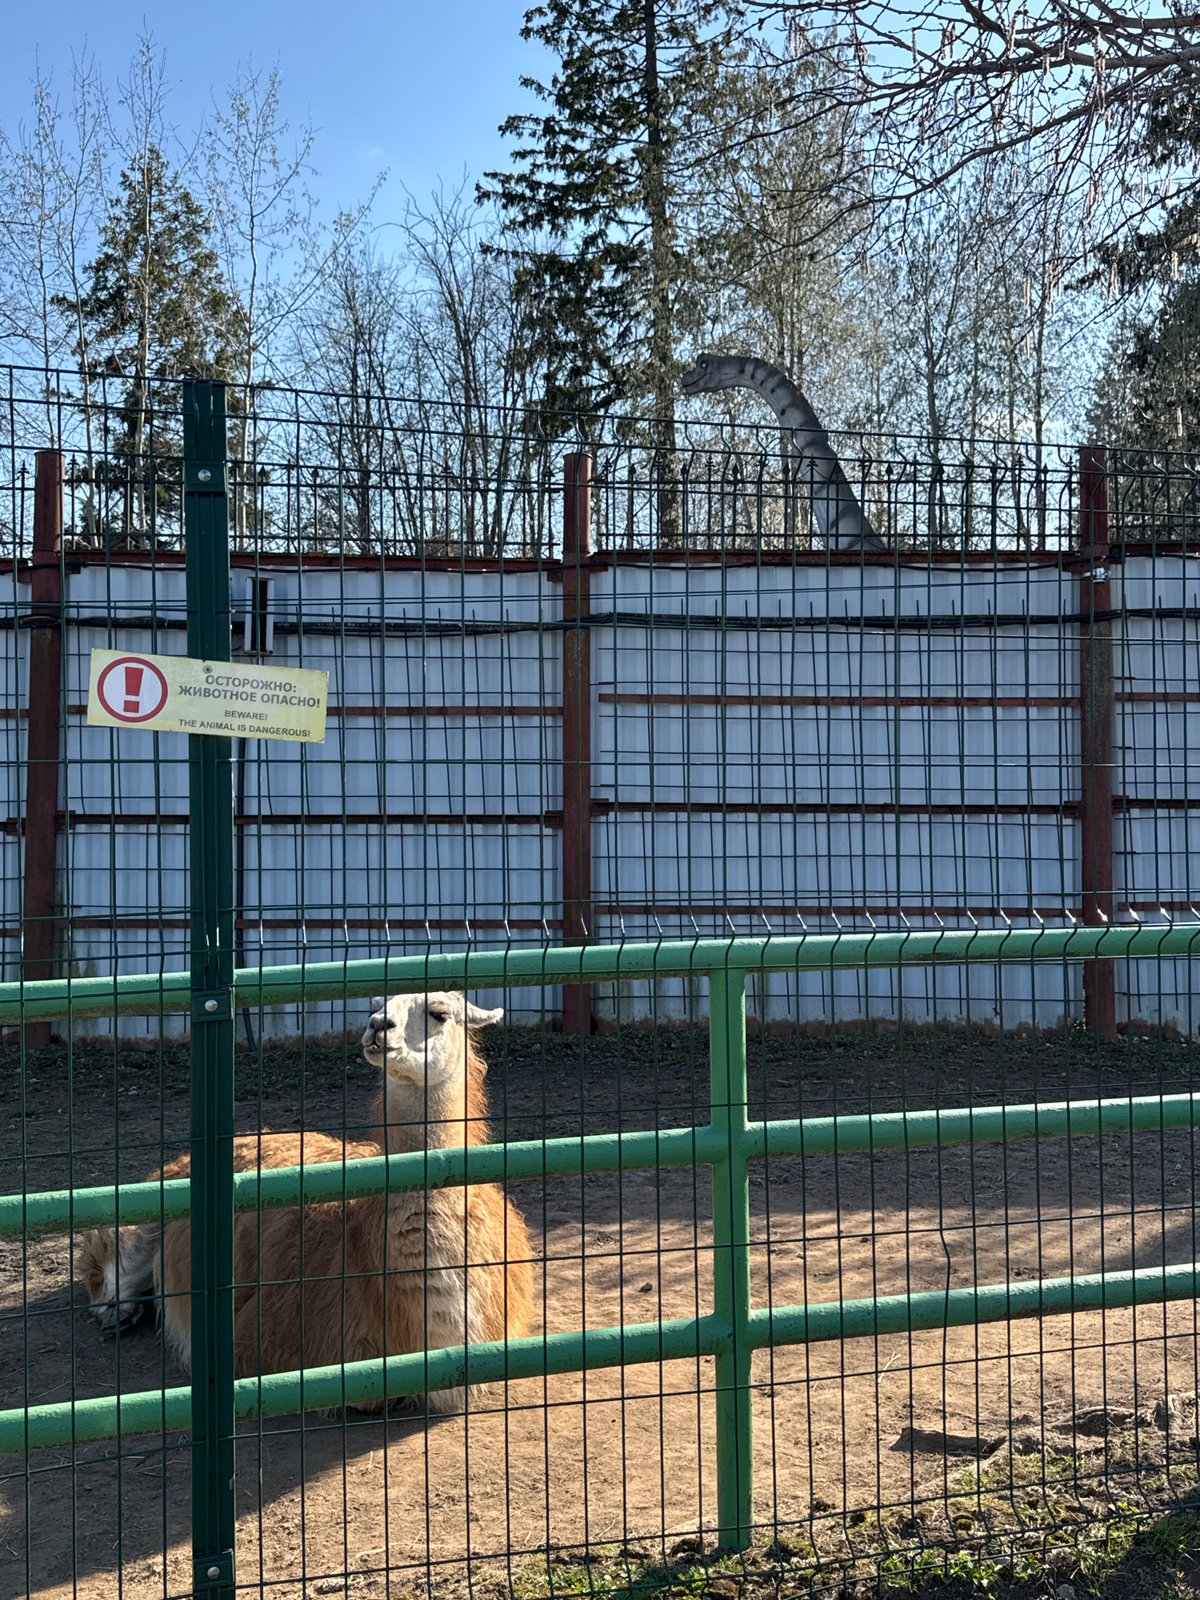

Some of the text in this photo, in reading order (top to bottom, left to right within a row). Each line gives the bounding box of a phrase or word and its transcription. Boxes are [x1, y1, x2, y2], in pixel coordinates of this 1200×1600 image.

[205, 674, 297, 693] ОСТОРОЖНО:
[178, 685, 321, 708] ЖИВОТНОЕ ОПАСНО!
[224, 709, 268, 721] BEWARE!
[178, 718, 311, 738] THE ANIMAL IS DANGEROUS!
